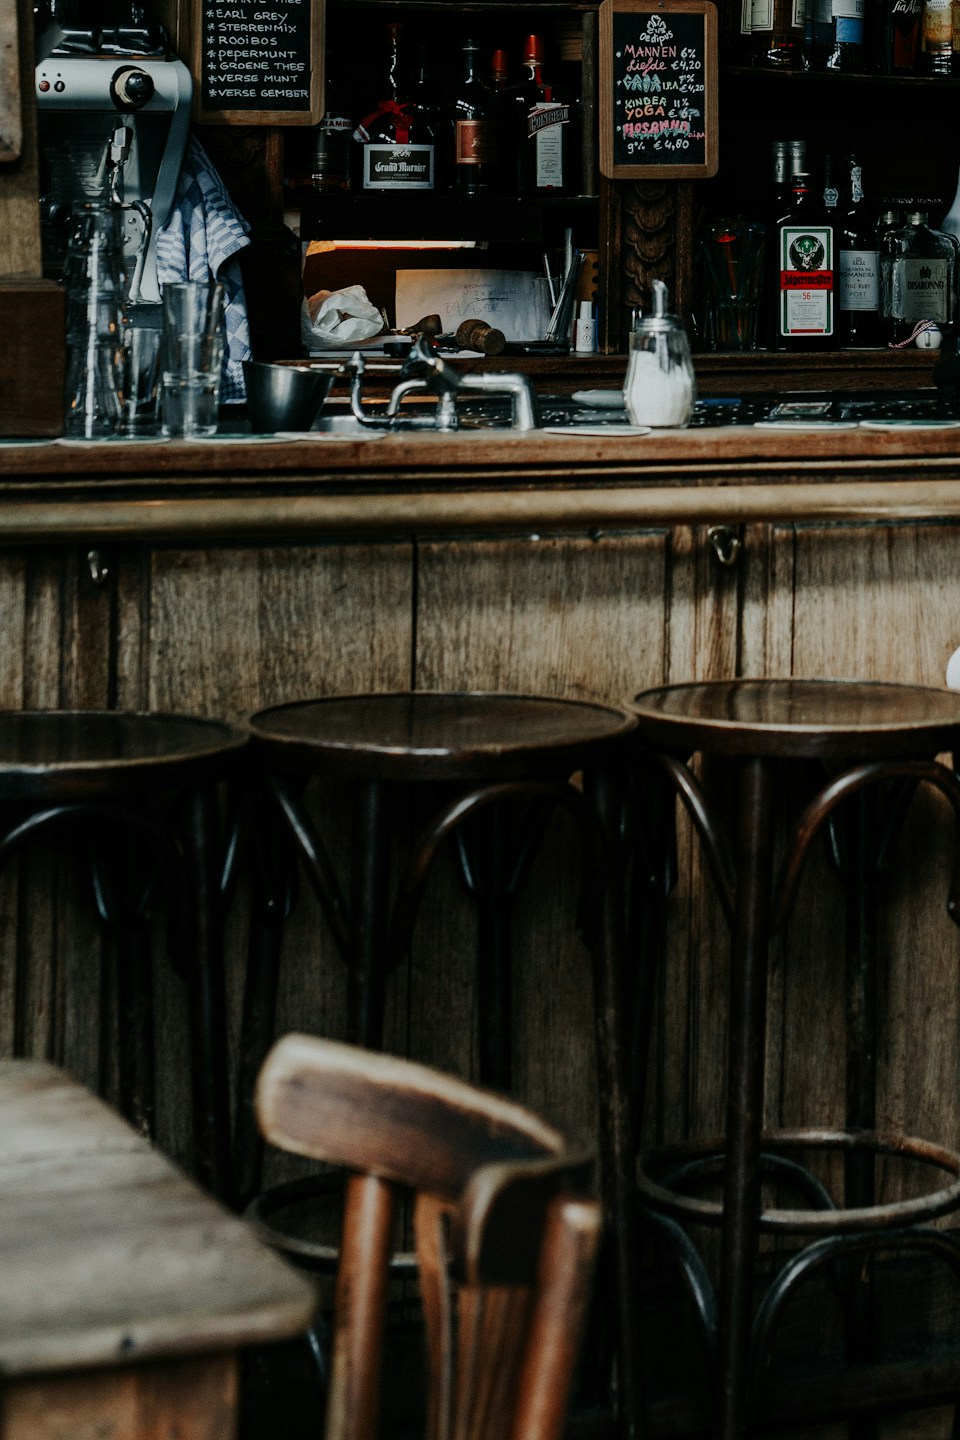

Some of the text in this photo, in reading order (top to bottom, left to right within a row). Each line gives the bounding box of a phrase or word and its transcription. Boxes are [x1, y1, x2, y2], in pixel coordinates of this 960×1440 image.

[216, 9, 288, 25] EARL GREY
[639, 30, 674, 47] Oedipus
[624, 44, 697, 59] MANNEN 6%
[219, 61, 306, 71] GROENE THEE
[626, 58, 701, 77] Liefde €4,20
[218, 74, 299, 83] VERSE MUNT
[218, 89, 309, 98] VERSE GEMBER
[624, 96, 668, 109] KINDER
[624, 105, 666, 121] YOGA
[374, 162, 427, 173] Grand Marnier
[907, 280, 944, 290] DISARONNO
[802, 291, 811, 301] 56
